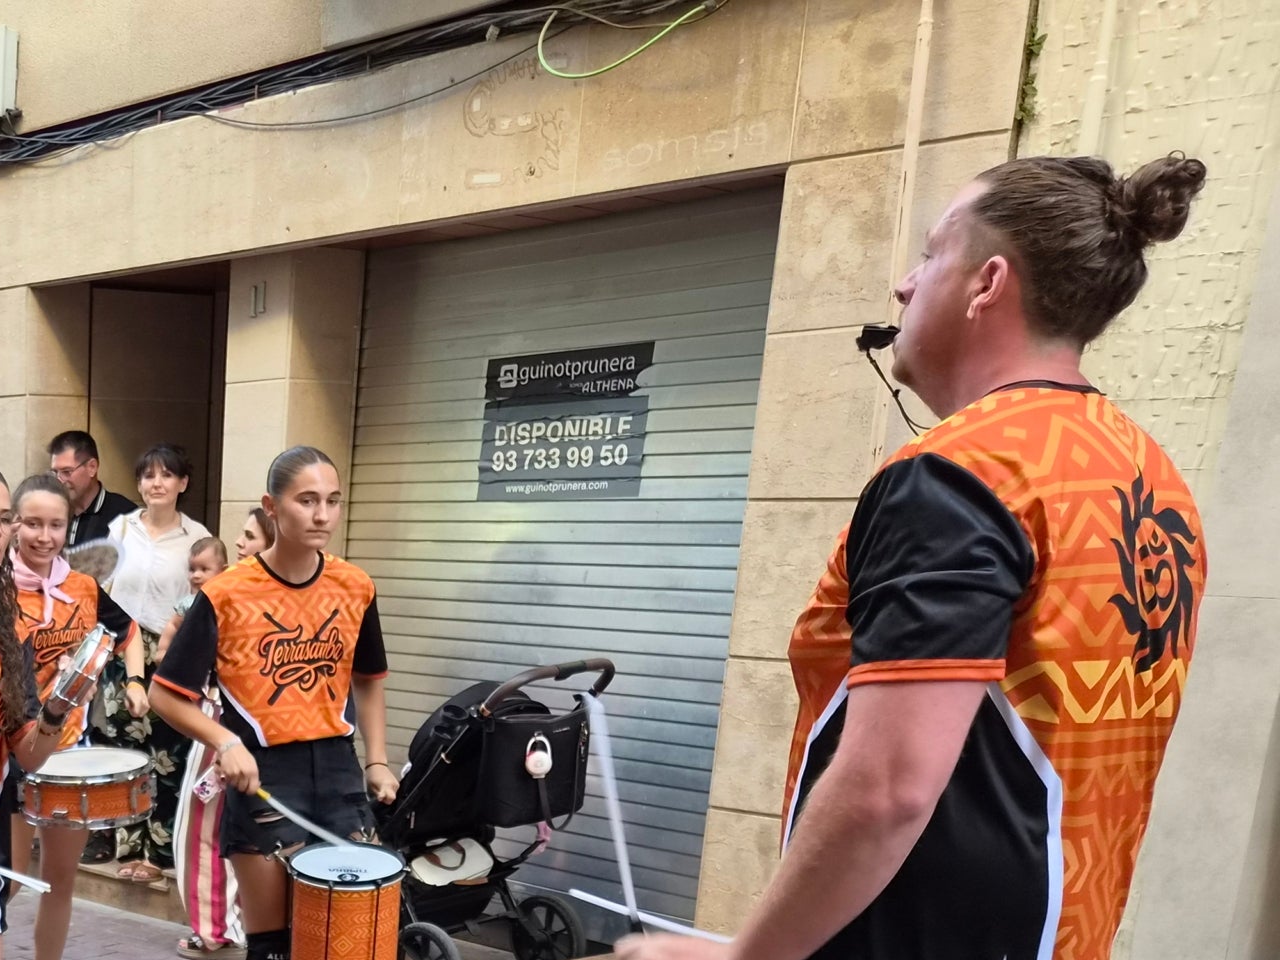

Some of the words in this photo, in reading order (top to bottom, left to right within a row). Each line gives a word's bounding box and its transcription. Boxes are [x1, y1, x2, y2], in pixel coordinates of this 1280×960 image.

[520, 356, 636, 385] guinotprunera
[582, 379, 634, 393] ALTHENA
[492, 451, 517, 471] 93
[523, 447, 560, 470] 733
[566, 446, 593, 468] 99
[600, 443, 628, 466] 50
[505, 481, 608, 494] www.guinotprunera.com
[258, 624, 343, 676] Terrasamba
